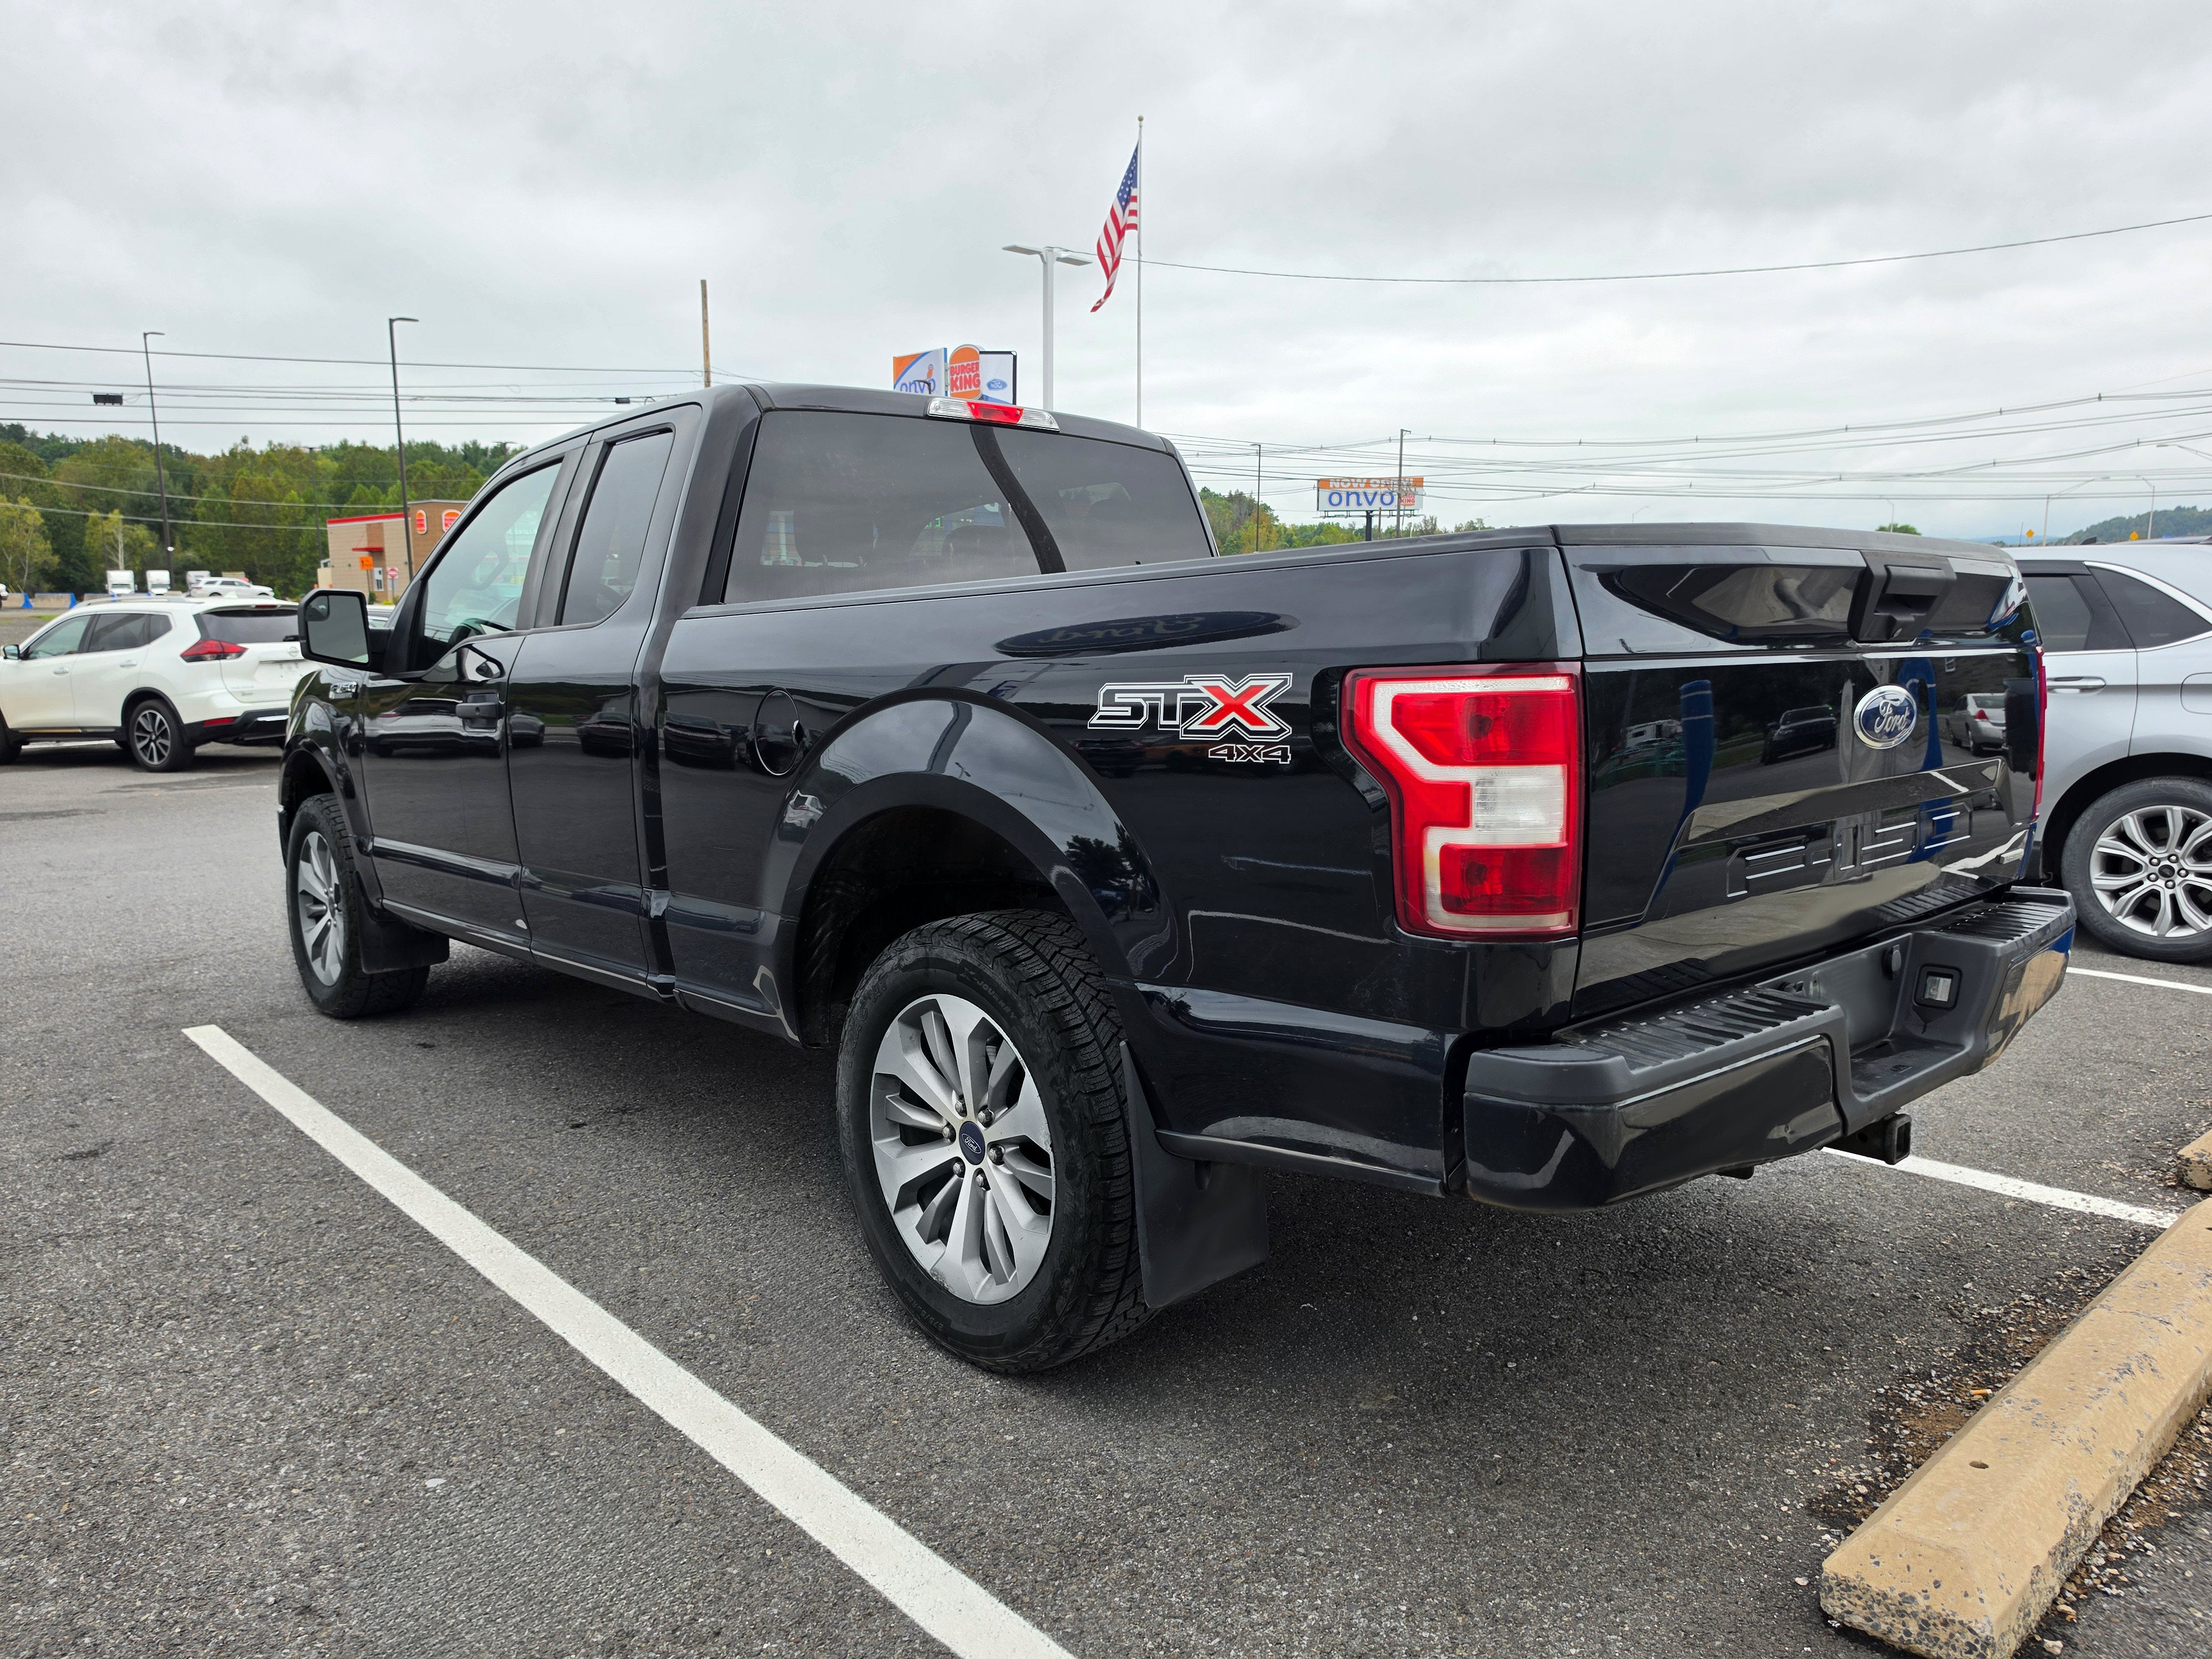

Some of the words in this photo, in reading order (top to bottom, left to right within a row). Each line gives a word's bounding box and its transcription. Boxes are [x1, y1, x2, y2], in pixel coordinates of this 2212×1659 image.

[950, 362, 979, 376] BURGER
[950, 375, 980, 391] KING
[1329, 478, 1364, 488] NOW
[1328, 491, 1394, 507] onvo
[1088, 672, 1293, 742] STX
[1874, 699, 1911, 733] Ford
[1726, 801, 1973, 898] F-150
[964, 1136, 978, 1151] Ford
